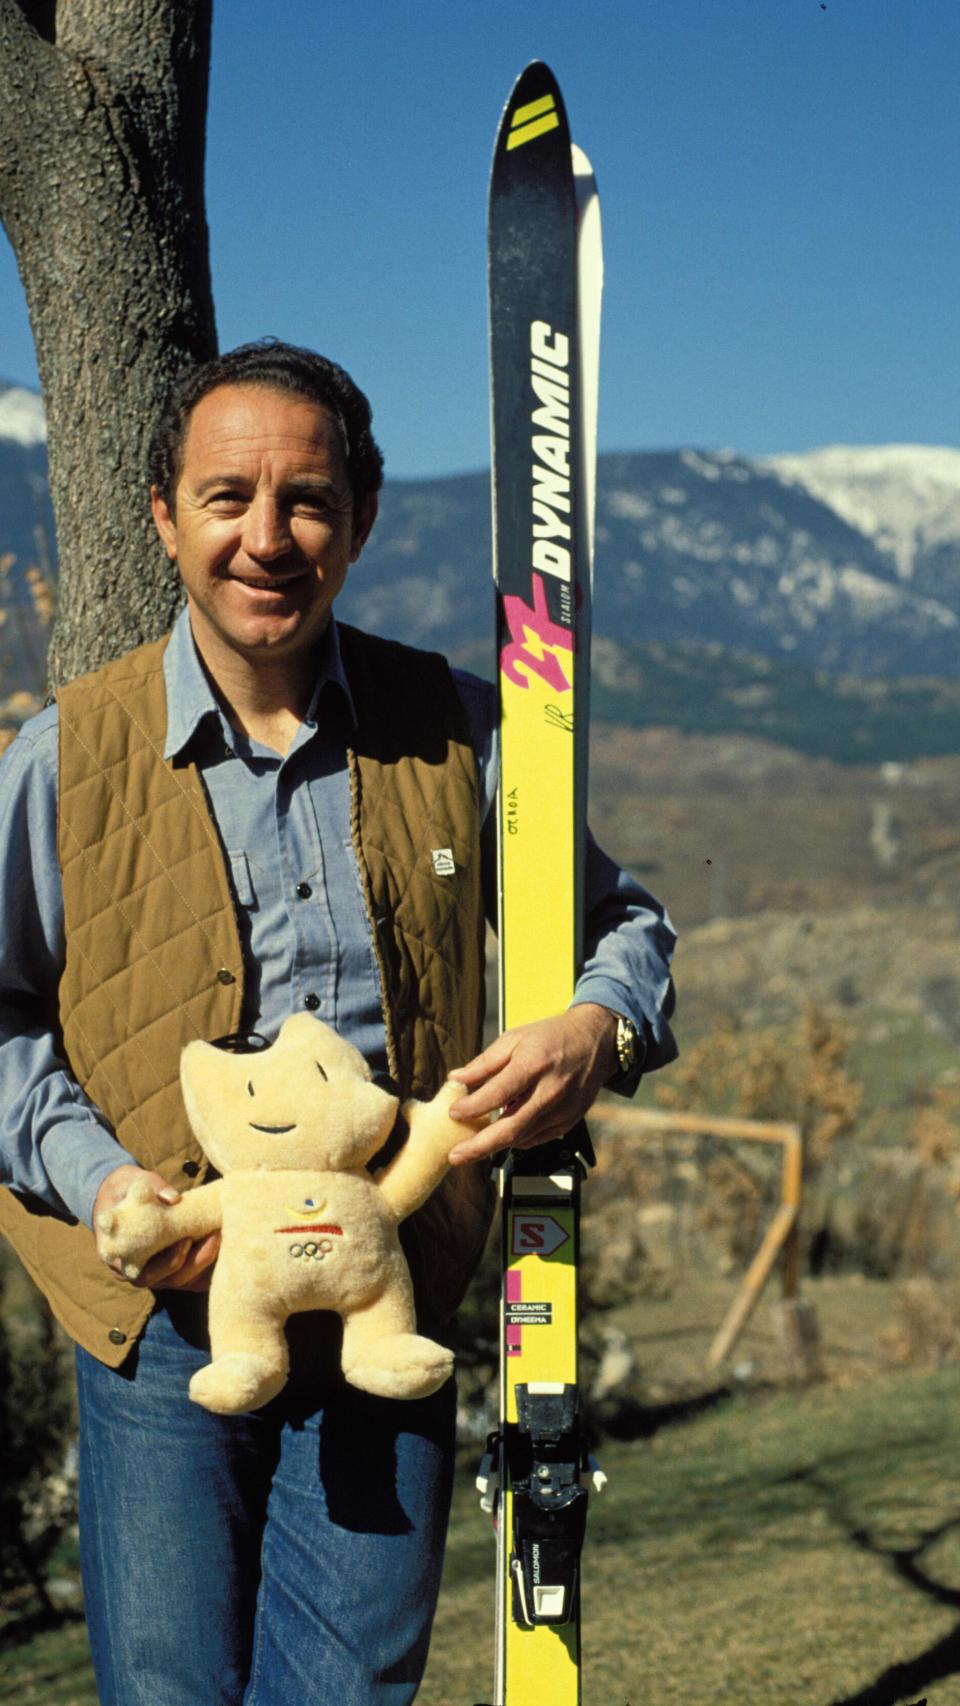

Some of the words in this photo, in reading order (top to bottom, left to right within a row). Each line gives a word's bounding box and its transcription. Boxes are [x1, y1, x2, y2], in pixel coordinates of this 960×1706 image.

[531, 320, 571, 582] DYNAMIC
[560, 583, 571, 624] SLALOM
[520, 1223, 544, 1247] S
[532, 1543, 540, 1584] SALOMON
